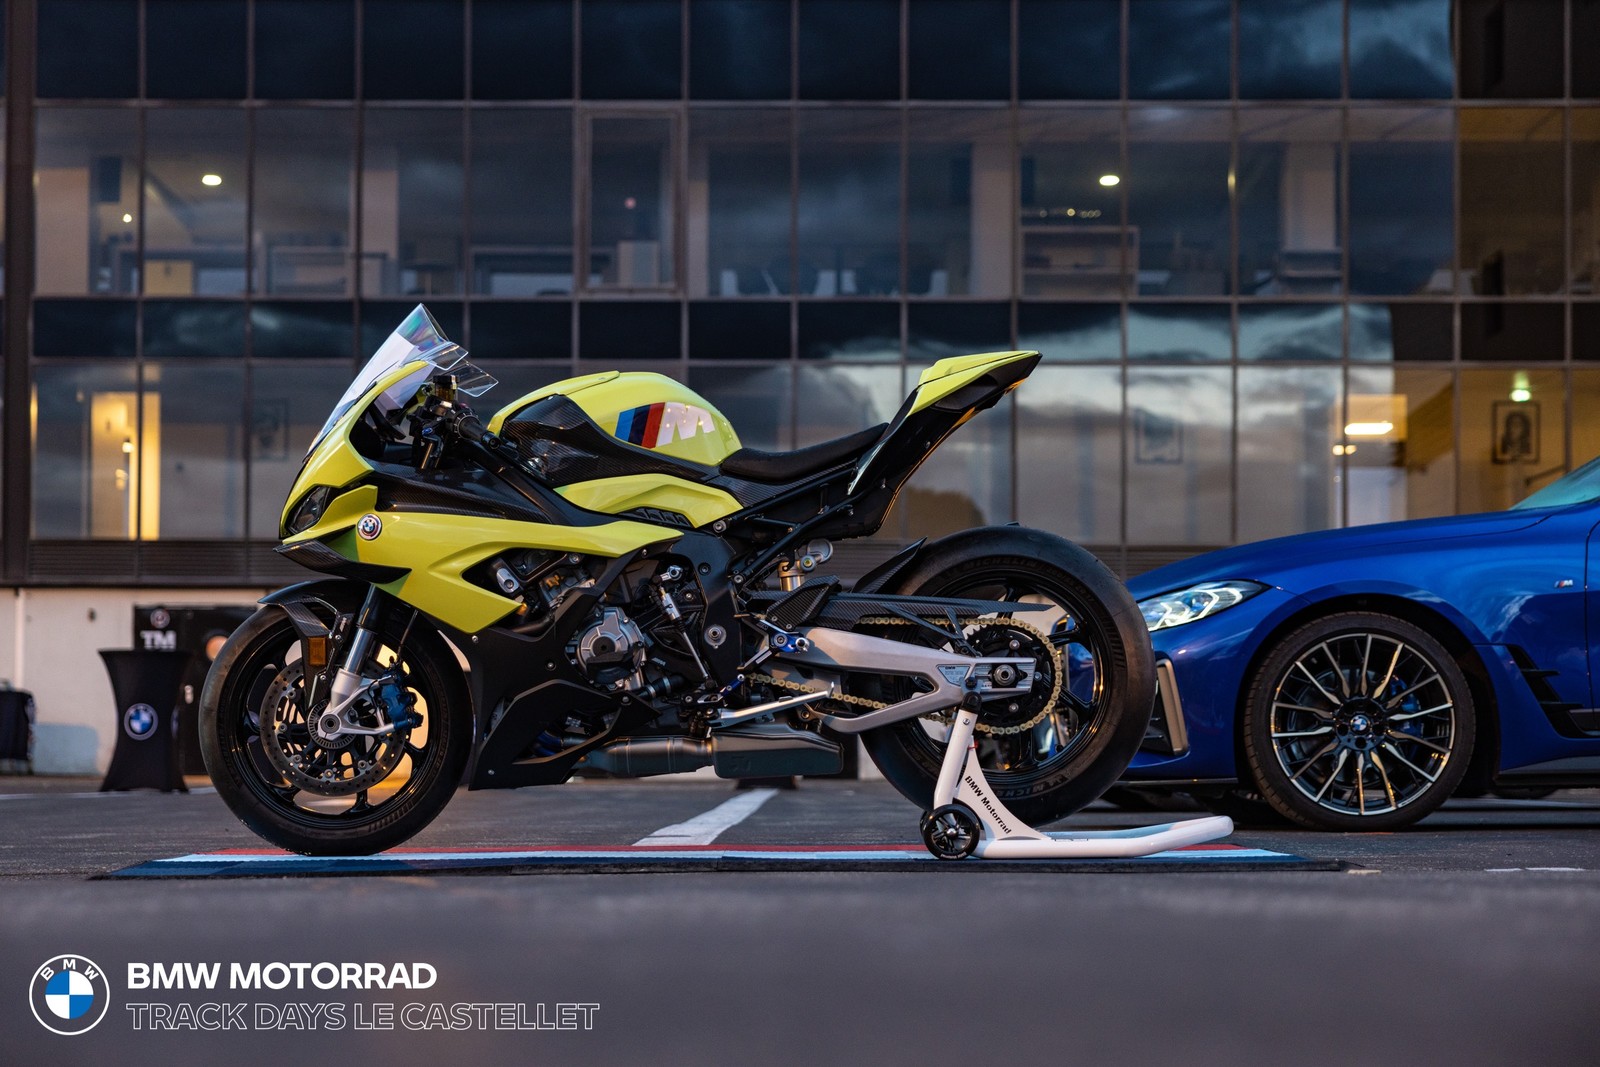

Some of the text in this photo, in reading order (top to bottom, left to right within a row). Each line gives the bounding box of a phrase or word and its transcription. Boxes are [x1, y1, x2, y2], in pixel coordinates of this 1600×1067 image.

[656, 402, 716, 447] M
[964, 775, 1013, 835] BMW Motorrad
[997, 784, 1044, 797] MICHE
